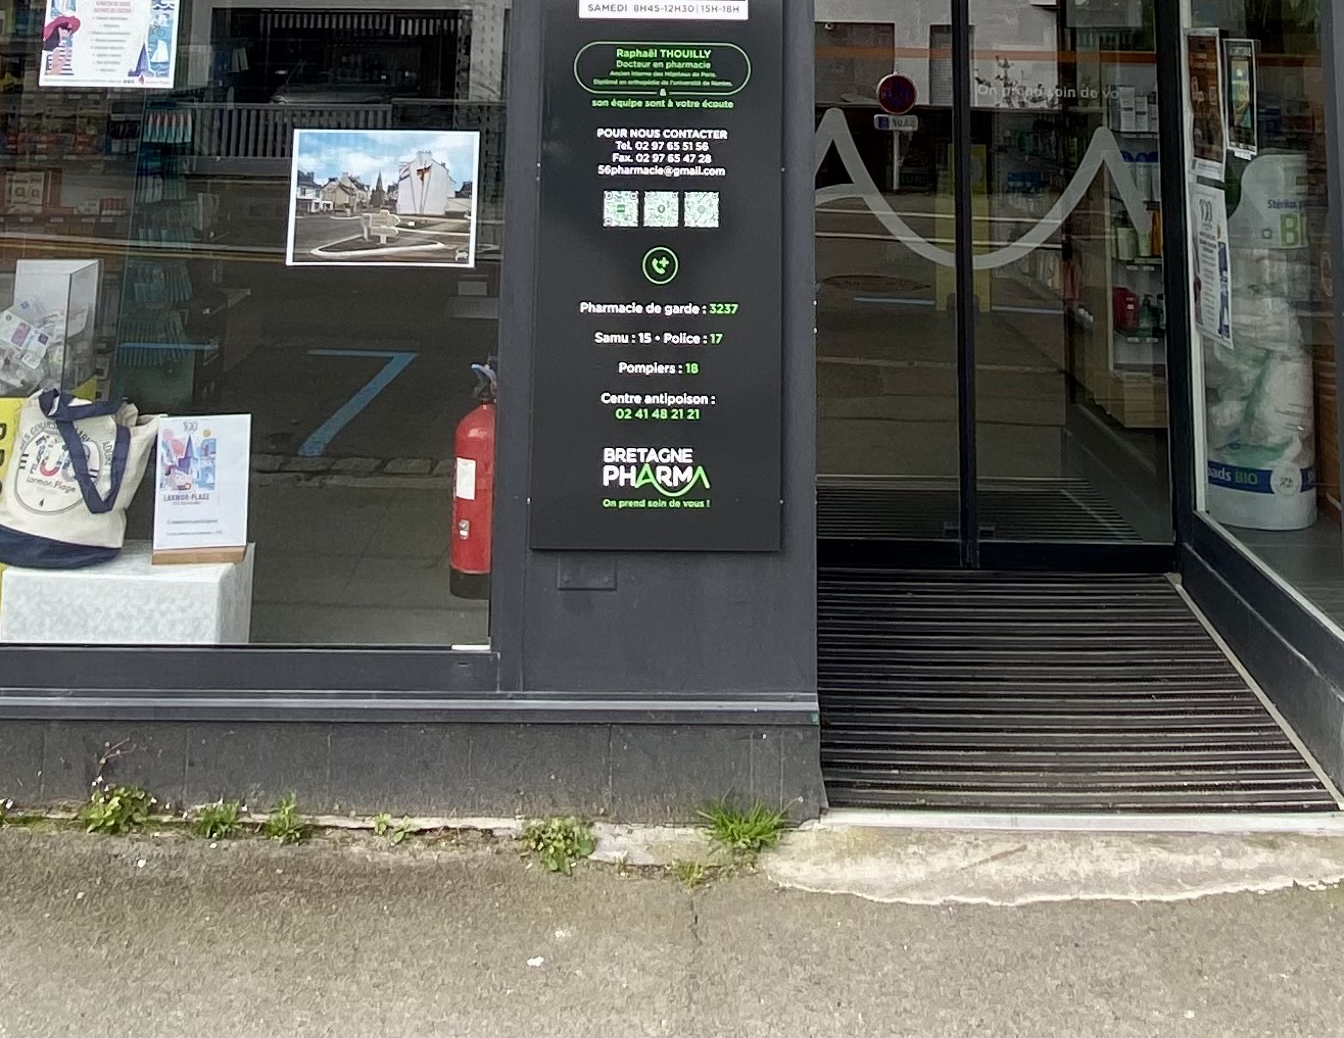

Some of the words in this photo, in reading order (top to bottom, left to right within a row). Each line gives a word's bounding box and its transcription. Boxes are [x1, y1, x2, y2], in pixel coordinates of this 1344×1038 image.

[587, 3, 628, 13] SAMEDI
[616, 48, 658, 59] Raphaël
[659, 49, 712, 59] THOUILLY
[616, 61, 652, 69] Docteur
[665, 61, 712, 72] pharmacie
[659, 87, 667, 97] &
[977, 85, 998, 97] On
[1080, 86, 1098, 99] de
[610, 98, 643, 110] équipe
[644, 100, 666, 108] sont
[667, 98, 674, 108] à
[675, 100, 700, 109] votre
[701, 99, 735, 109] écoute
[596, 128, 628, 139] POUR
[629, 128, 661, 139] NOUS
[662, 129, 728, 140] CONTACTER
[634, 141, 649, 152] 02
[651, 141, 664, 152] 97
[666, 141, 680, 152] 65
[682, 141, 694, 152] 51
[695, 141, 710, 152] 56
[612, 153, 634, 164] Fax.
[635, 153, 650, 163] 02
[652, 153, 665, 163] 97
[667, 153, 681, 164] 65
[682, 153, 696, 164] 47
[698, 153, 712, 164] 28
[597, 165, 726, 177] 56pharmacie@gmail.com
[1280, 212, 1308, 247] BI
[579, 301, 644, 314] Pharmacie
[645, 302, 662, 315] de
[664, 303, 700, 316] garde
[709, 303, 739, 315] 3237
[594, 332, 629, 344] Samu
[638, 333, 652, 344] 15
[663, 333, 701, 345] Police
[709, 333, 723, 344] 17
[618, 362, 676, 377] Pompiers
[685, 363, 699, 375] 18
[600, 392, 642, 405] Centre
[644, 392, 709, 408] antipoison
[615, 409, 632, 420] 02
[634, 409, 649, 420] 41
[651, 409, 668, 420] 48
[671, 409, 685, 420] 21
[686, 409, 701, 420] 21
[603, 447, 694, 464] BRETAGNE
[603, 463, 711, 497] PHARMA
[1235, 470, 1258, 485] BIO
[602, 498, 616, 508] On
[618, 499, 646, 510] prend
[647, 499, 668, 508] soin
[668, 498, 681, 508] de
[682, 499, 705, 508] vous
